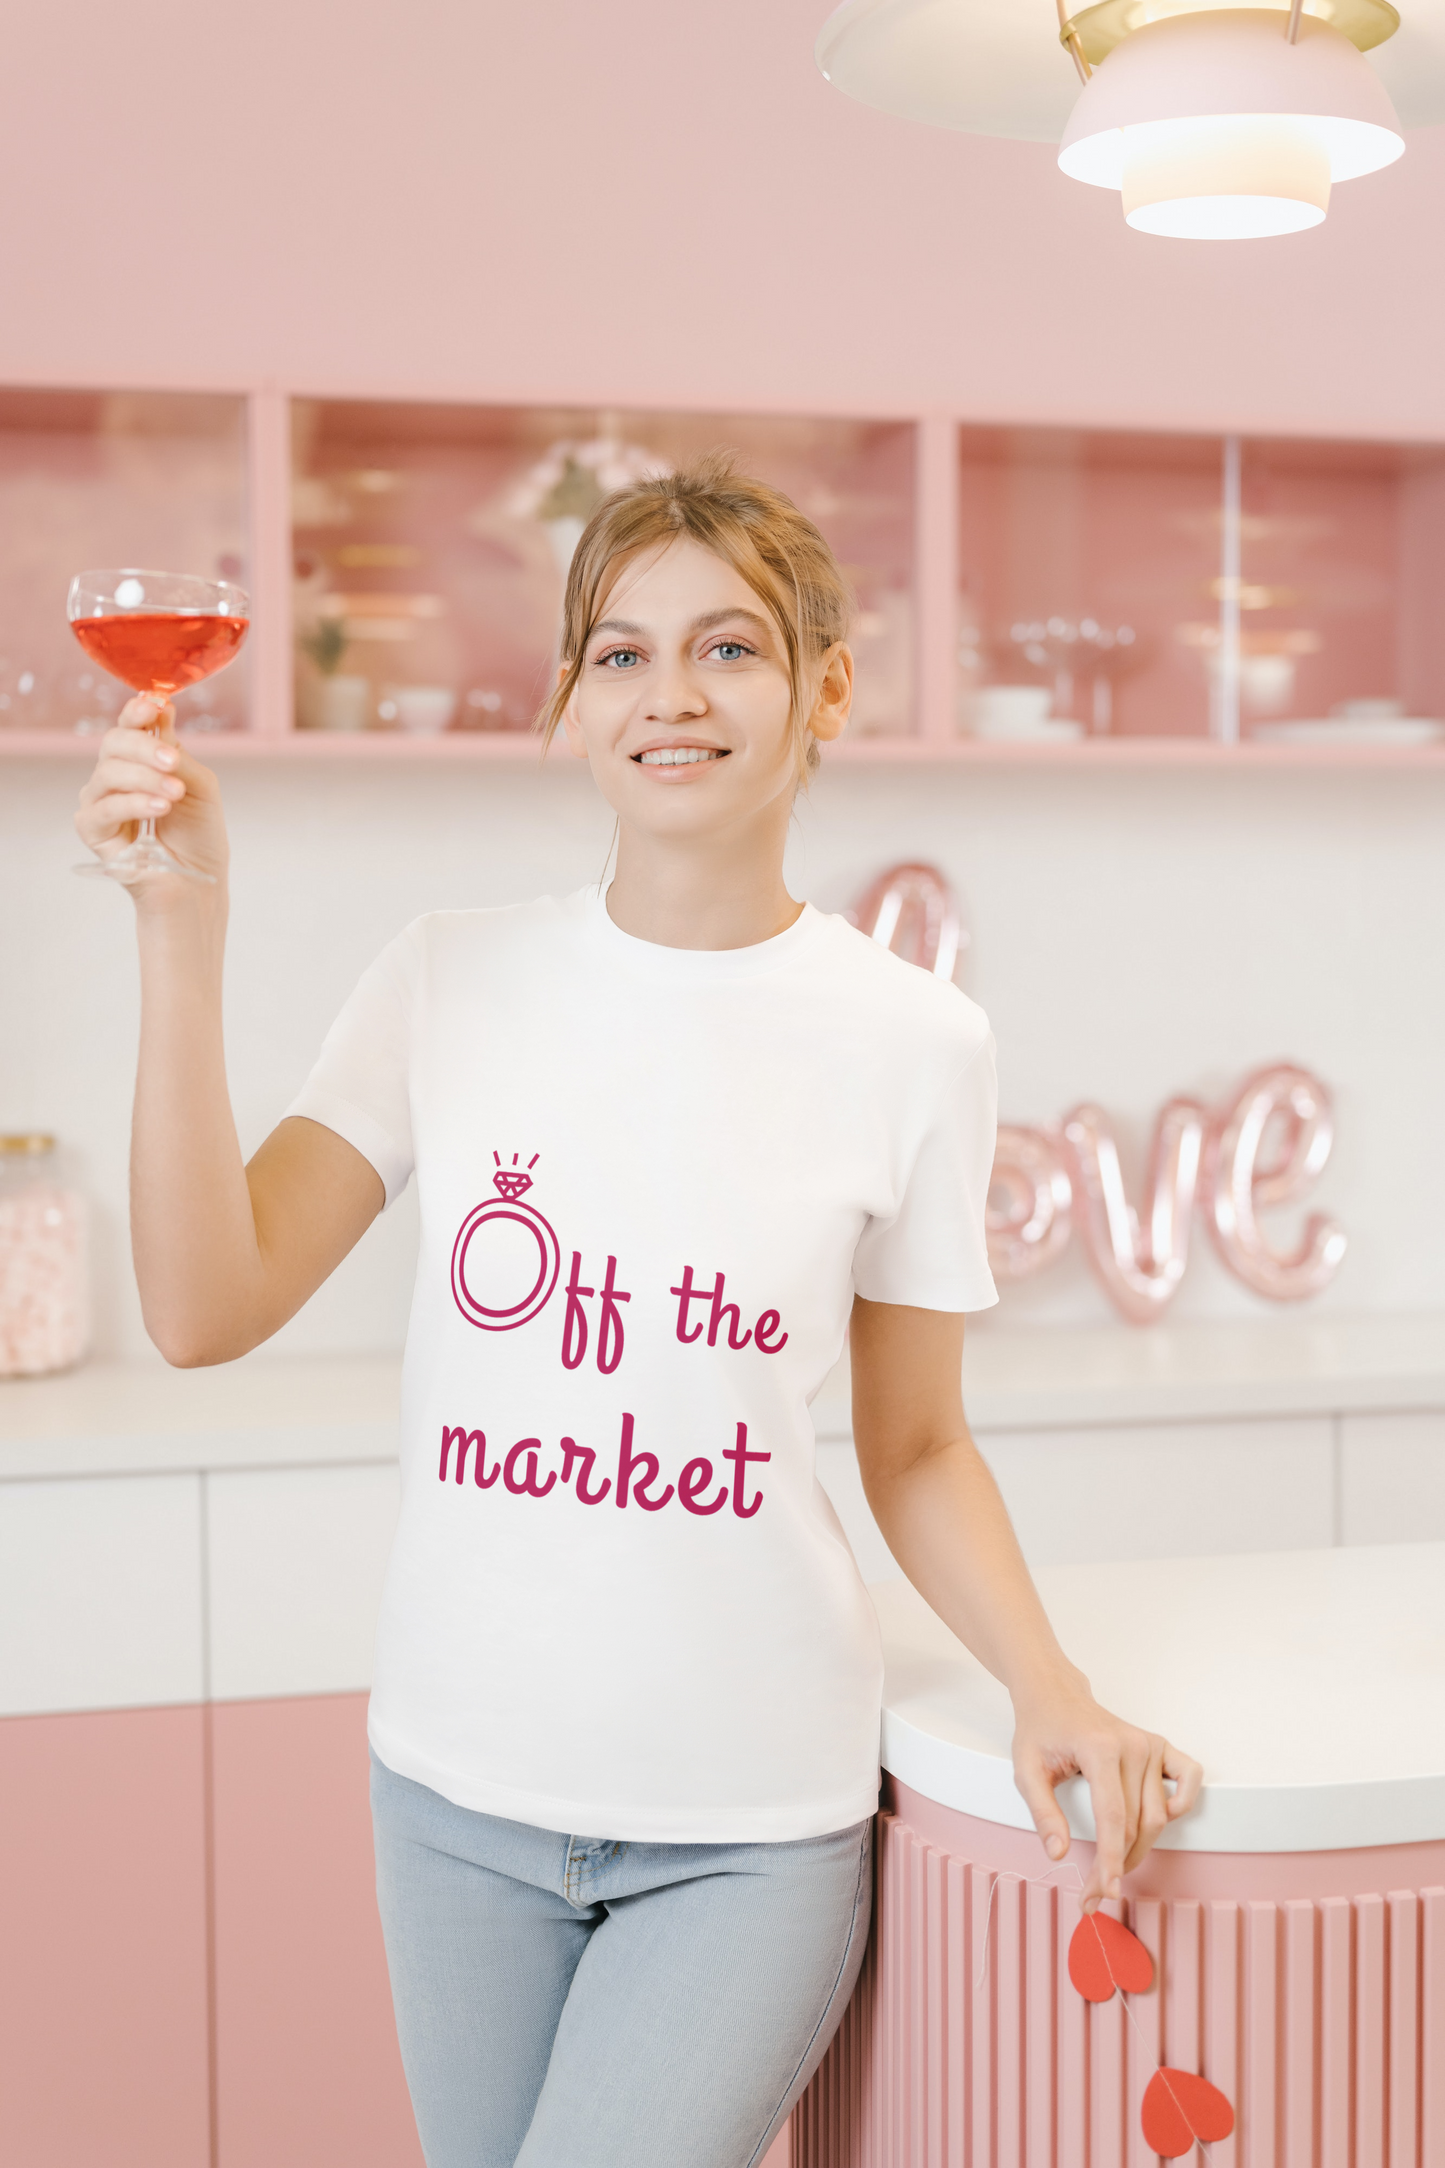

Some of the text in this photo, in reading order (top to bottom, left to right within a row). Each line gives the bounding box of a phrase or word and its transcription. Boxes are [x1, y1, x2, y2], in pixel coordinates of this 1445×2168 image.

[451, 1180, 789, 1375] Off the
[438, 1412, 772, 1519] market
